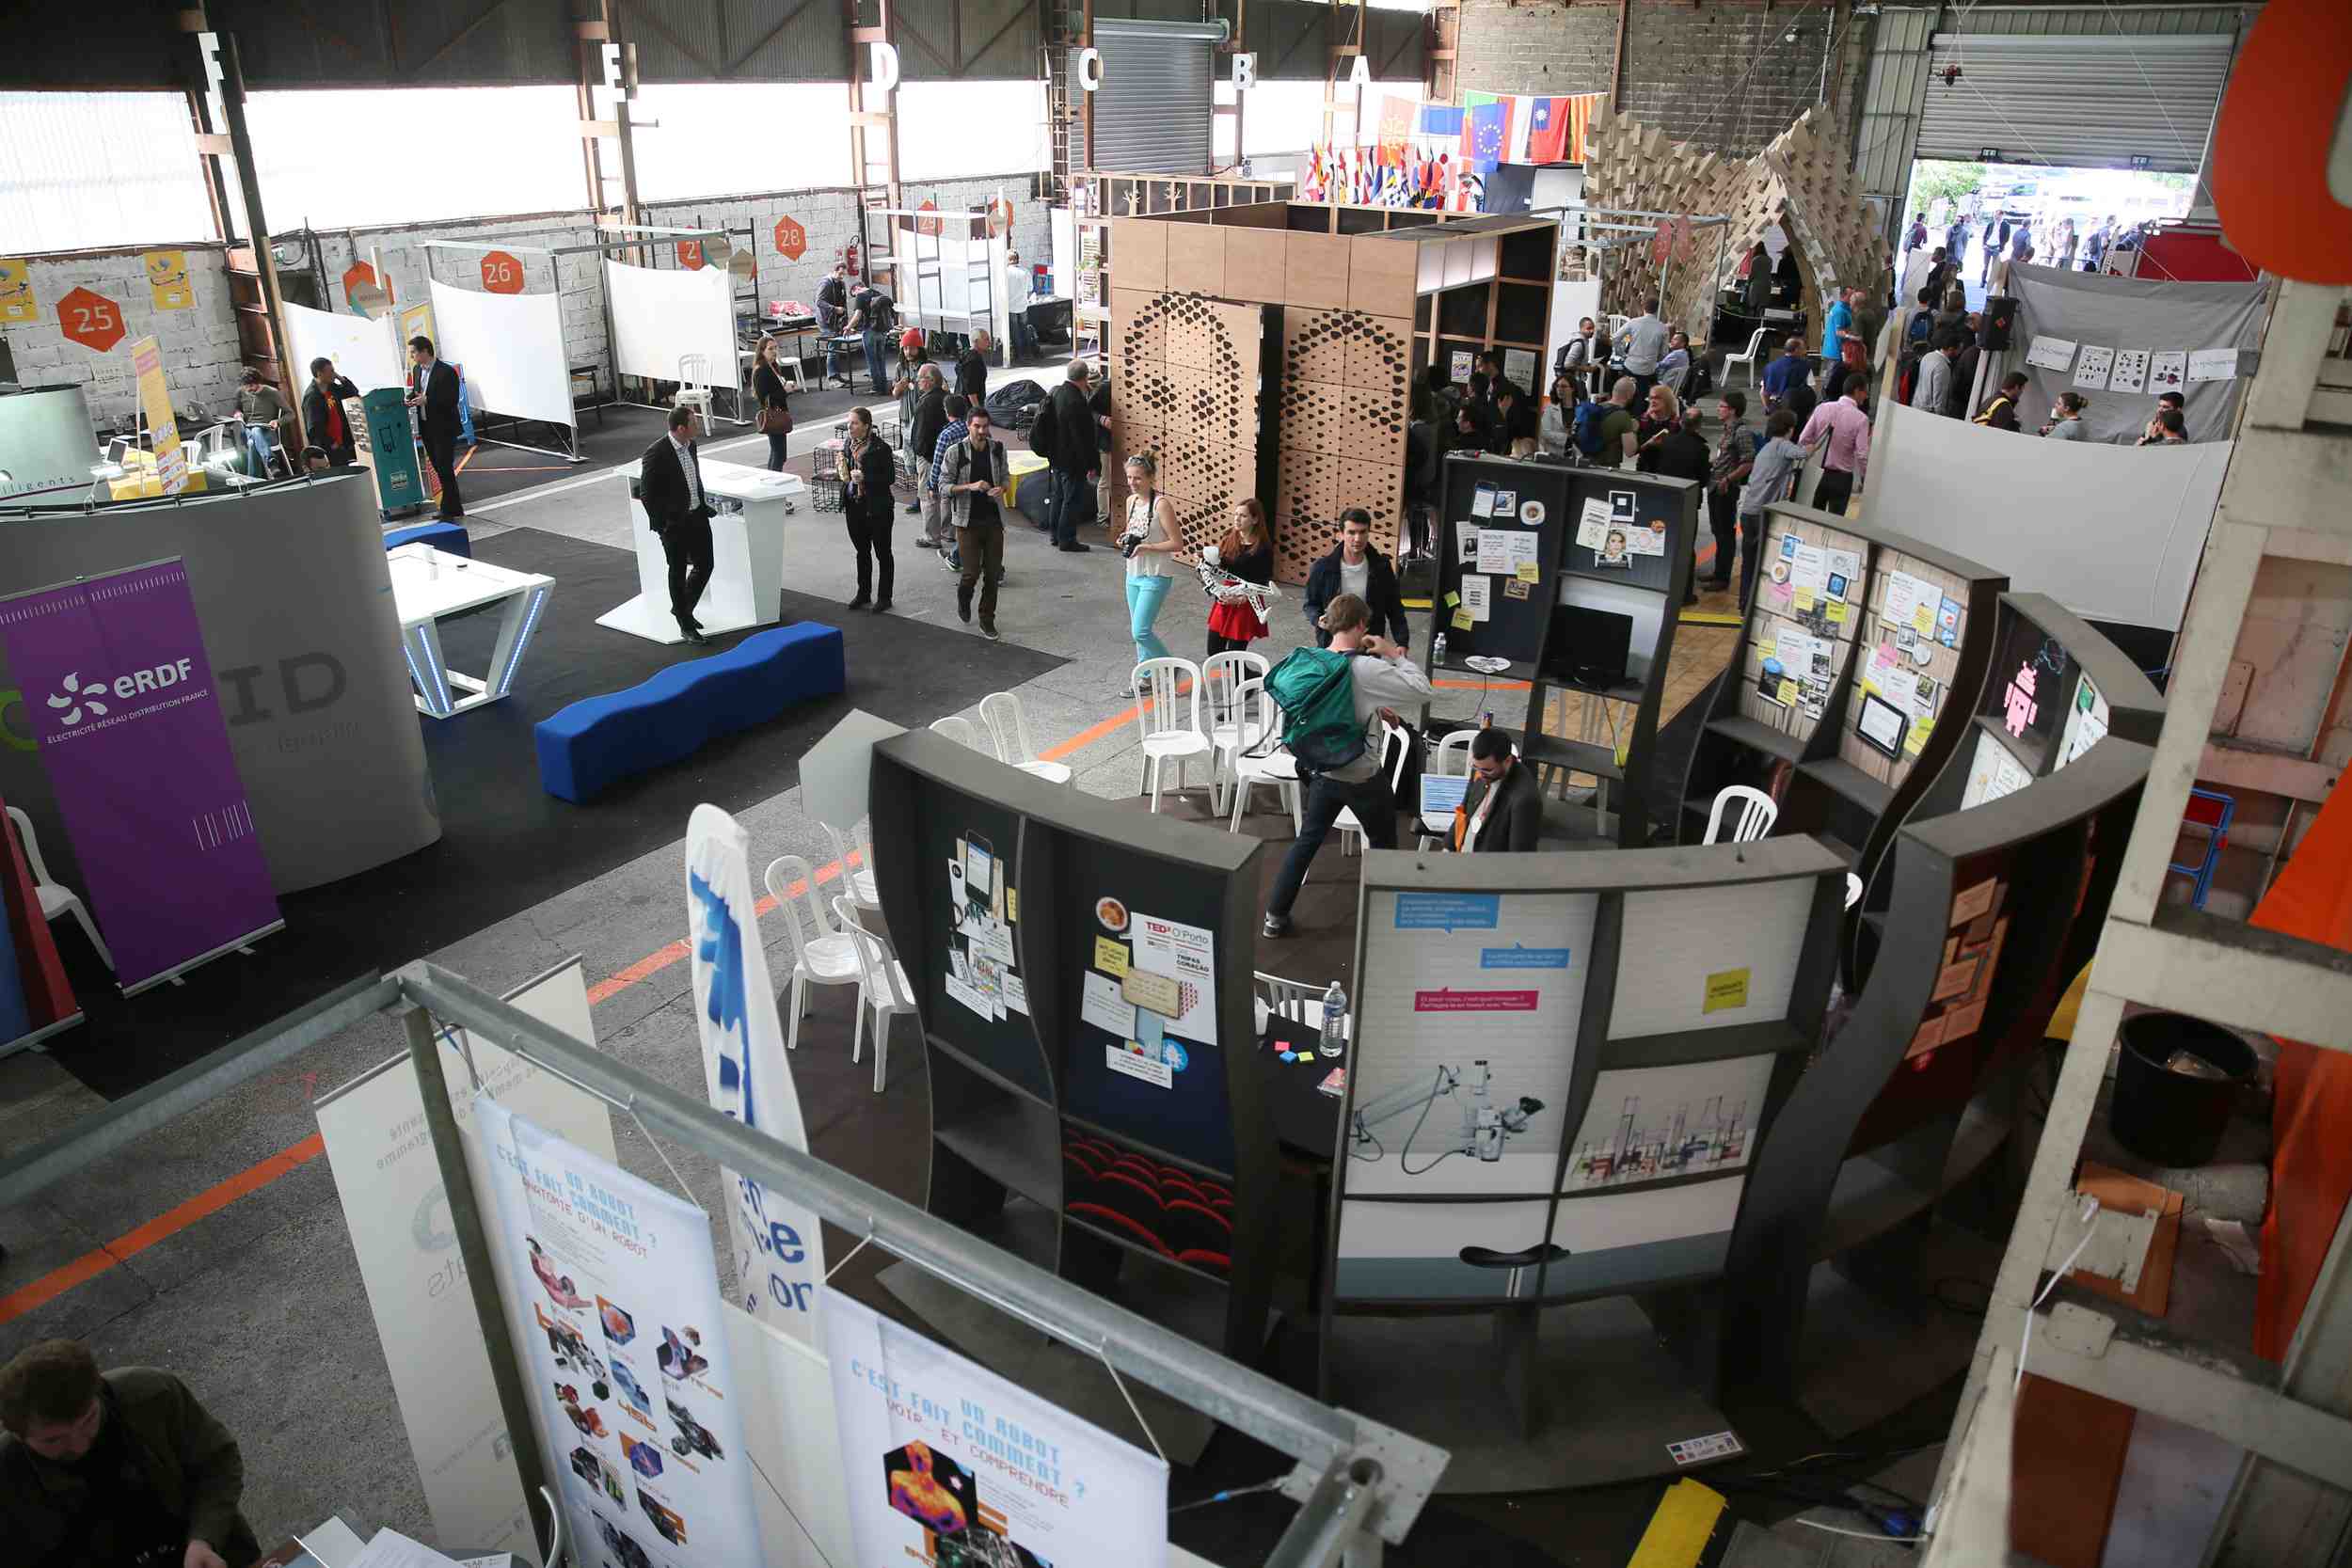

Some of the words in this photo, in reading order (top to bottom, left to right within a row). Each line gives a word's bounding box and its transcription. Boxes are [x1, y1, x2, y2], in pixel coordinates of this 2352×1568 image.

[198, 32, 229, 135] F
[602, 43, 627, 103] E
[870, 42, 898, 90] D
[1078, 48, 1099, 90] C
[1232, 54, 1253, 89] B
[1349, 55, 1371, 83] A
[781, 229, 800, 247] 28
[485, 262, 511, 284] 26
[72, 305, 113, 333] 25
[114, 657, 192, 699] eRDF
[911, 1391, 951, 1426] FAIT
[962, 1420, 1063, 1487] COMMENT
[995, 1416, 1060, 1465] ROBOT
[941, 1428, 960, 1447] ET
[970, 1445, 1070, 1510] COMPRENDRE
